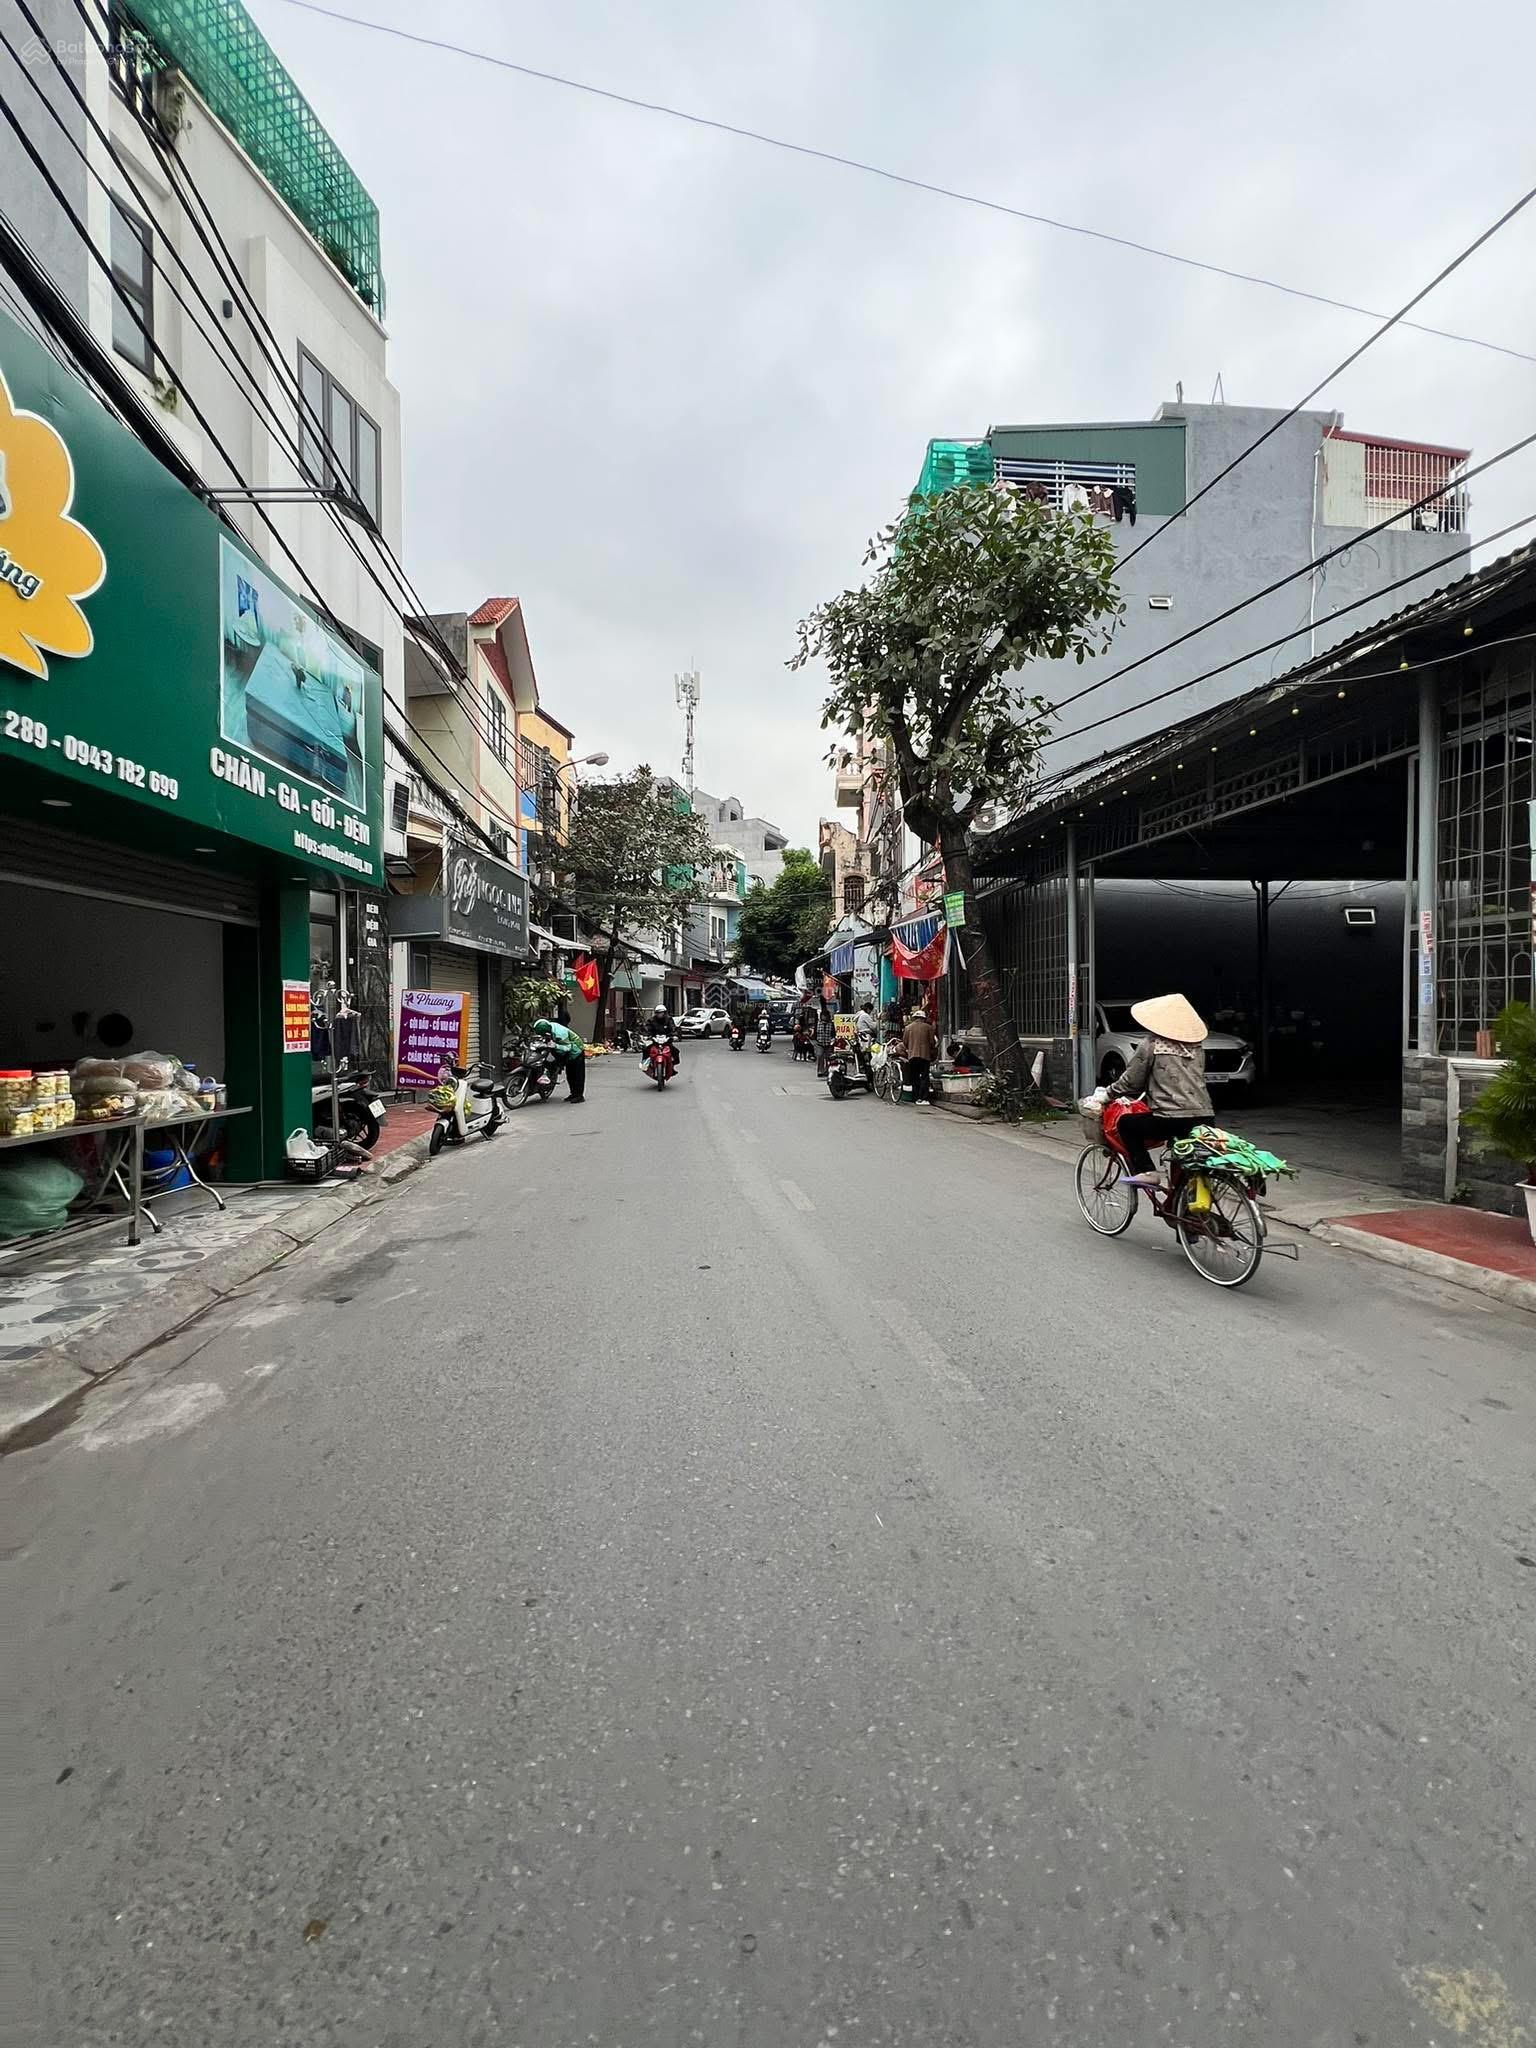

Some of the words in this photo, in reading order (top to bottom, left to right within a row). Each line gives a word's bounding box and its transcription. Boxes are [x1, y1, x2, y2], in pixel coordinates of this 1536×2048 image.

[4, 710, 47, 749] 289
[64, 734, 112, 774] 0943
[116, 757, 146, 788] 182
[149, 770, 179, 801] 699
[210, 747, 266, 798] CHĂN
[278, 782, 301, 815] GA
[311, 796, 335, 829] GỐI
[344, 814, 371, 847] ĐỆM
[416, 993, 455, 1011] Phương
